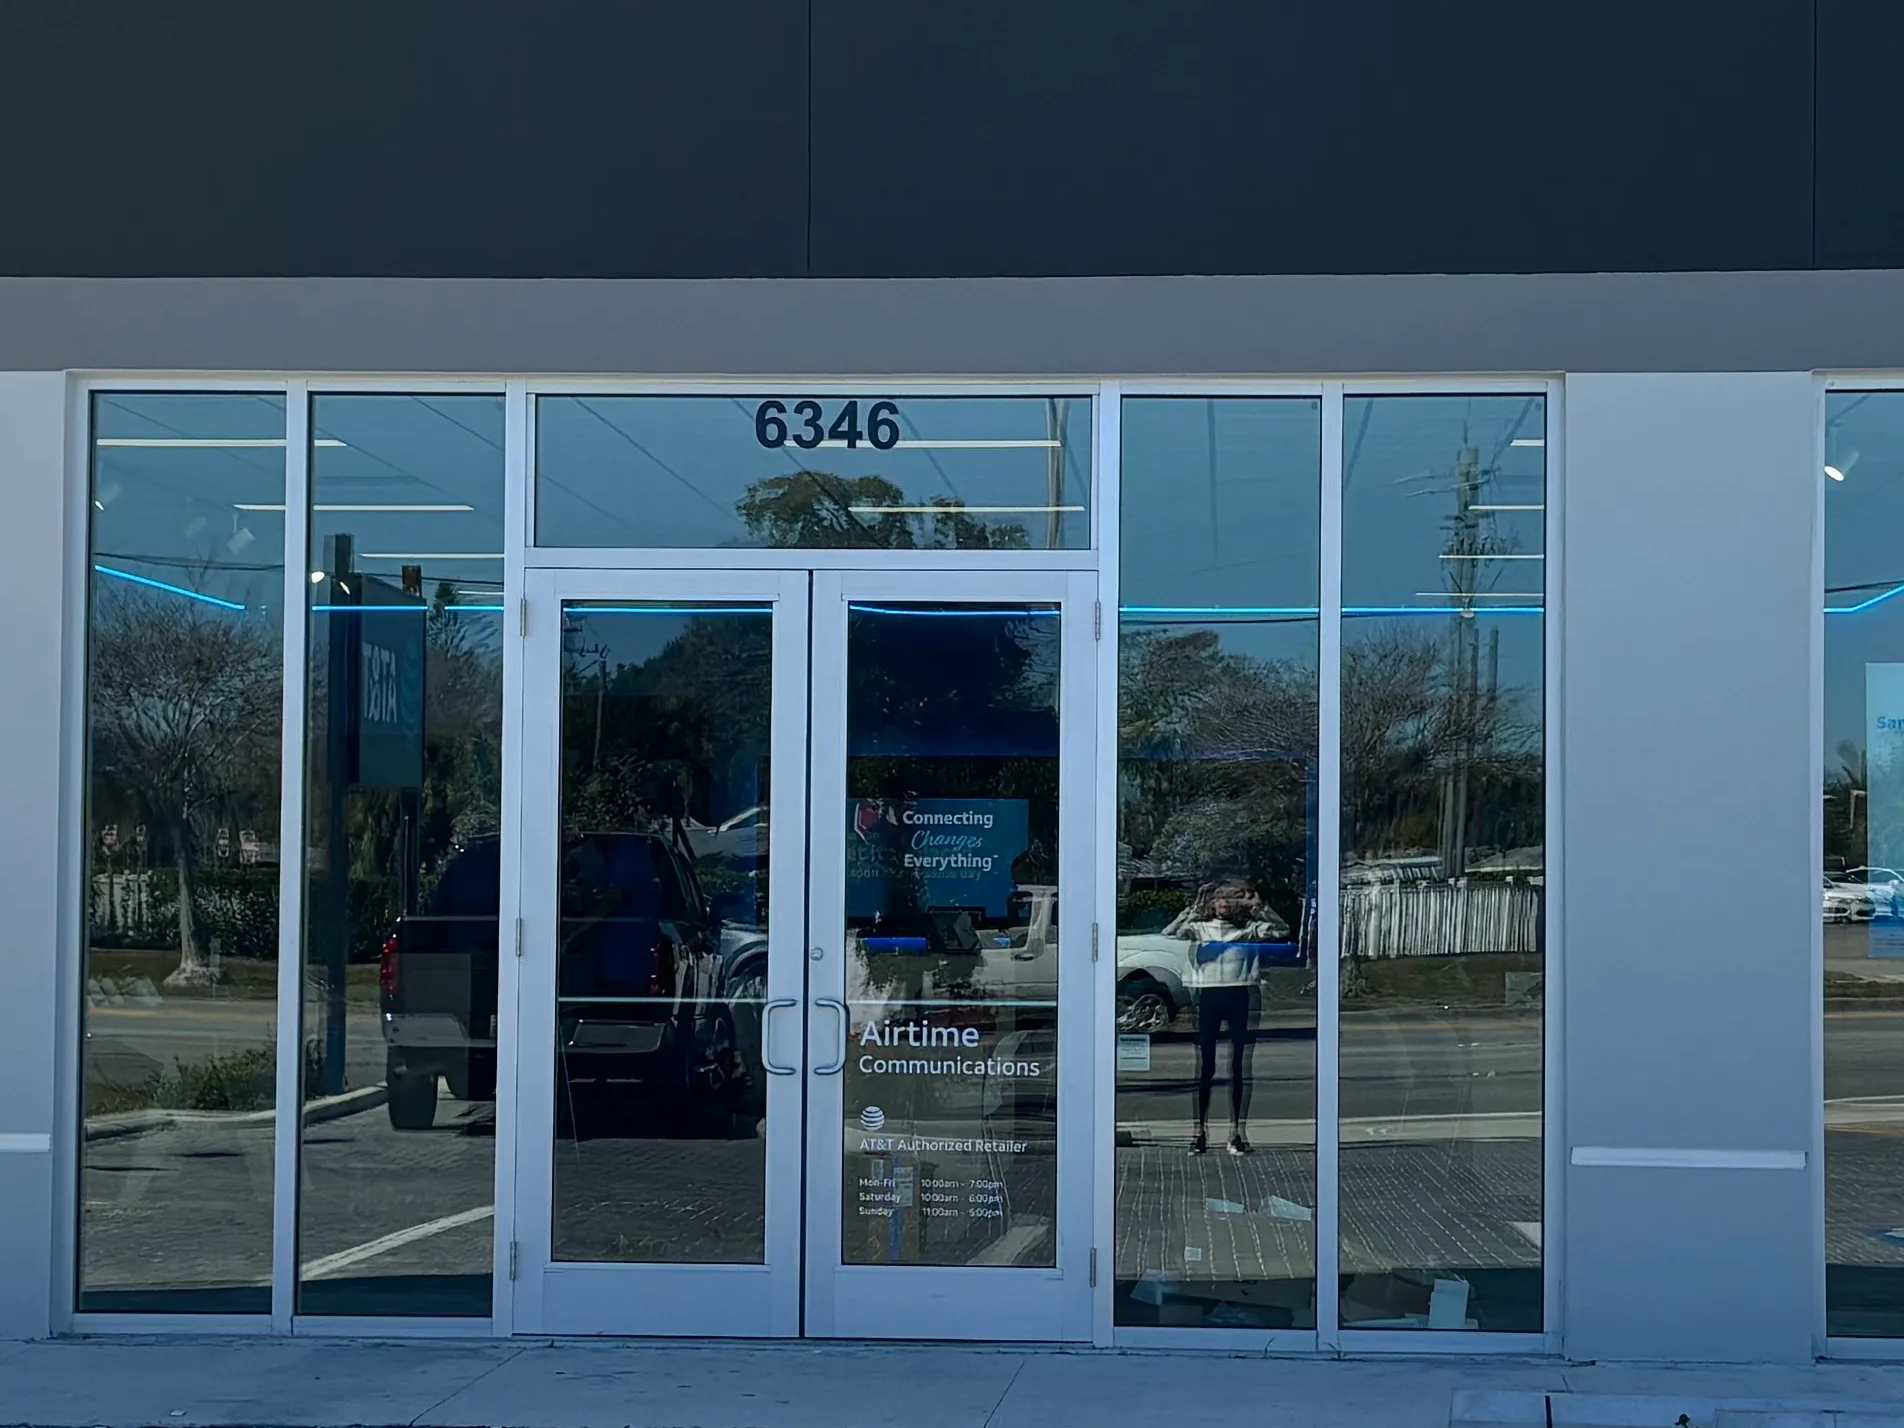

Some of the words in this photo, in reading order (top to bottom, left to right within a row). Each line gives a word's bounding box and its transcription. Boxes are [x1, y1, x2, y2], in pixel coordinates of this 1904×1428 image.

[754, 399, 901, 451] 6346
[902, 810, 994, 829] Connecting
[911, 829, 984, 852] Changes
[859, 1019, 980, 1048] Airtime
[859, 1055, 1041, 1077] Communications
[859, 1138, 894, 1152] AT&T
[897, 1139, 972, 1152] Authorized
[975, 1140, 1028, 1153] Retailer
[859, 1178, 896, 1188] Mon-Fri
[921, 1179, 960, 1189] 10:00am
[969, 1180, 1004, 1190] 7:00pm
[859, 1192, 902, 1204] Saturday
[921, 1193, 959, 1203] 10:00am
[968, 1194, 1004, 1204] 6:00pm
[859, 1207, 894, 1217] Sunday
[922, 1208, 959, 1217] 11:00am
[968, 1208, 1003, 1218] 5:00pm
